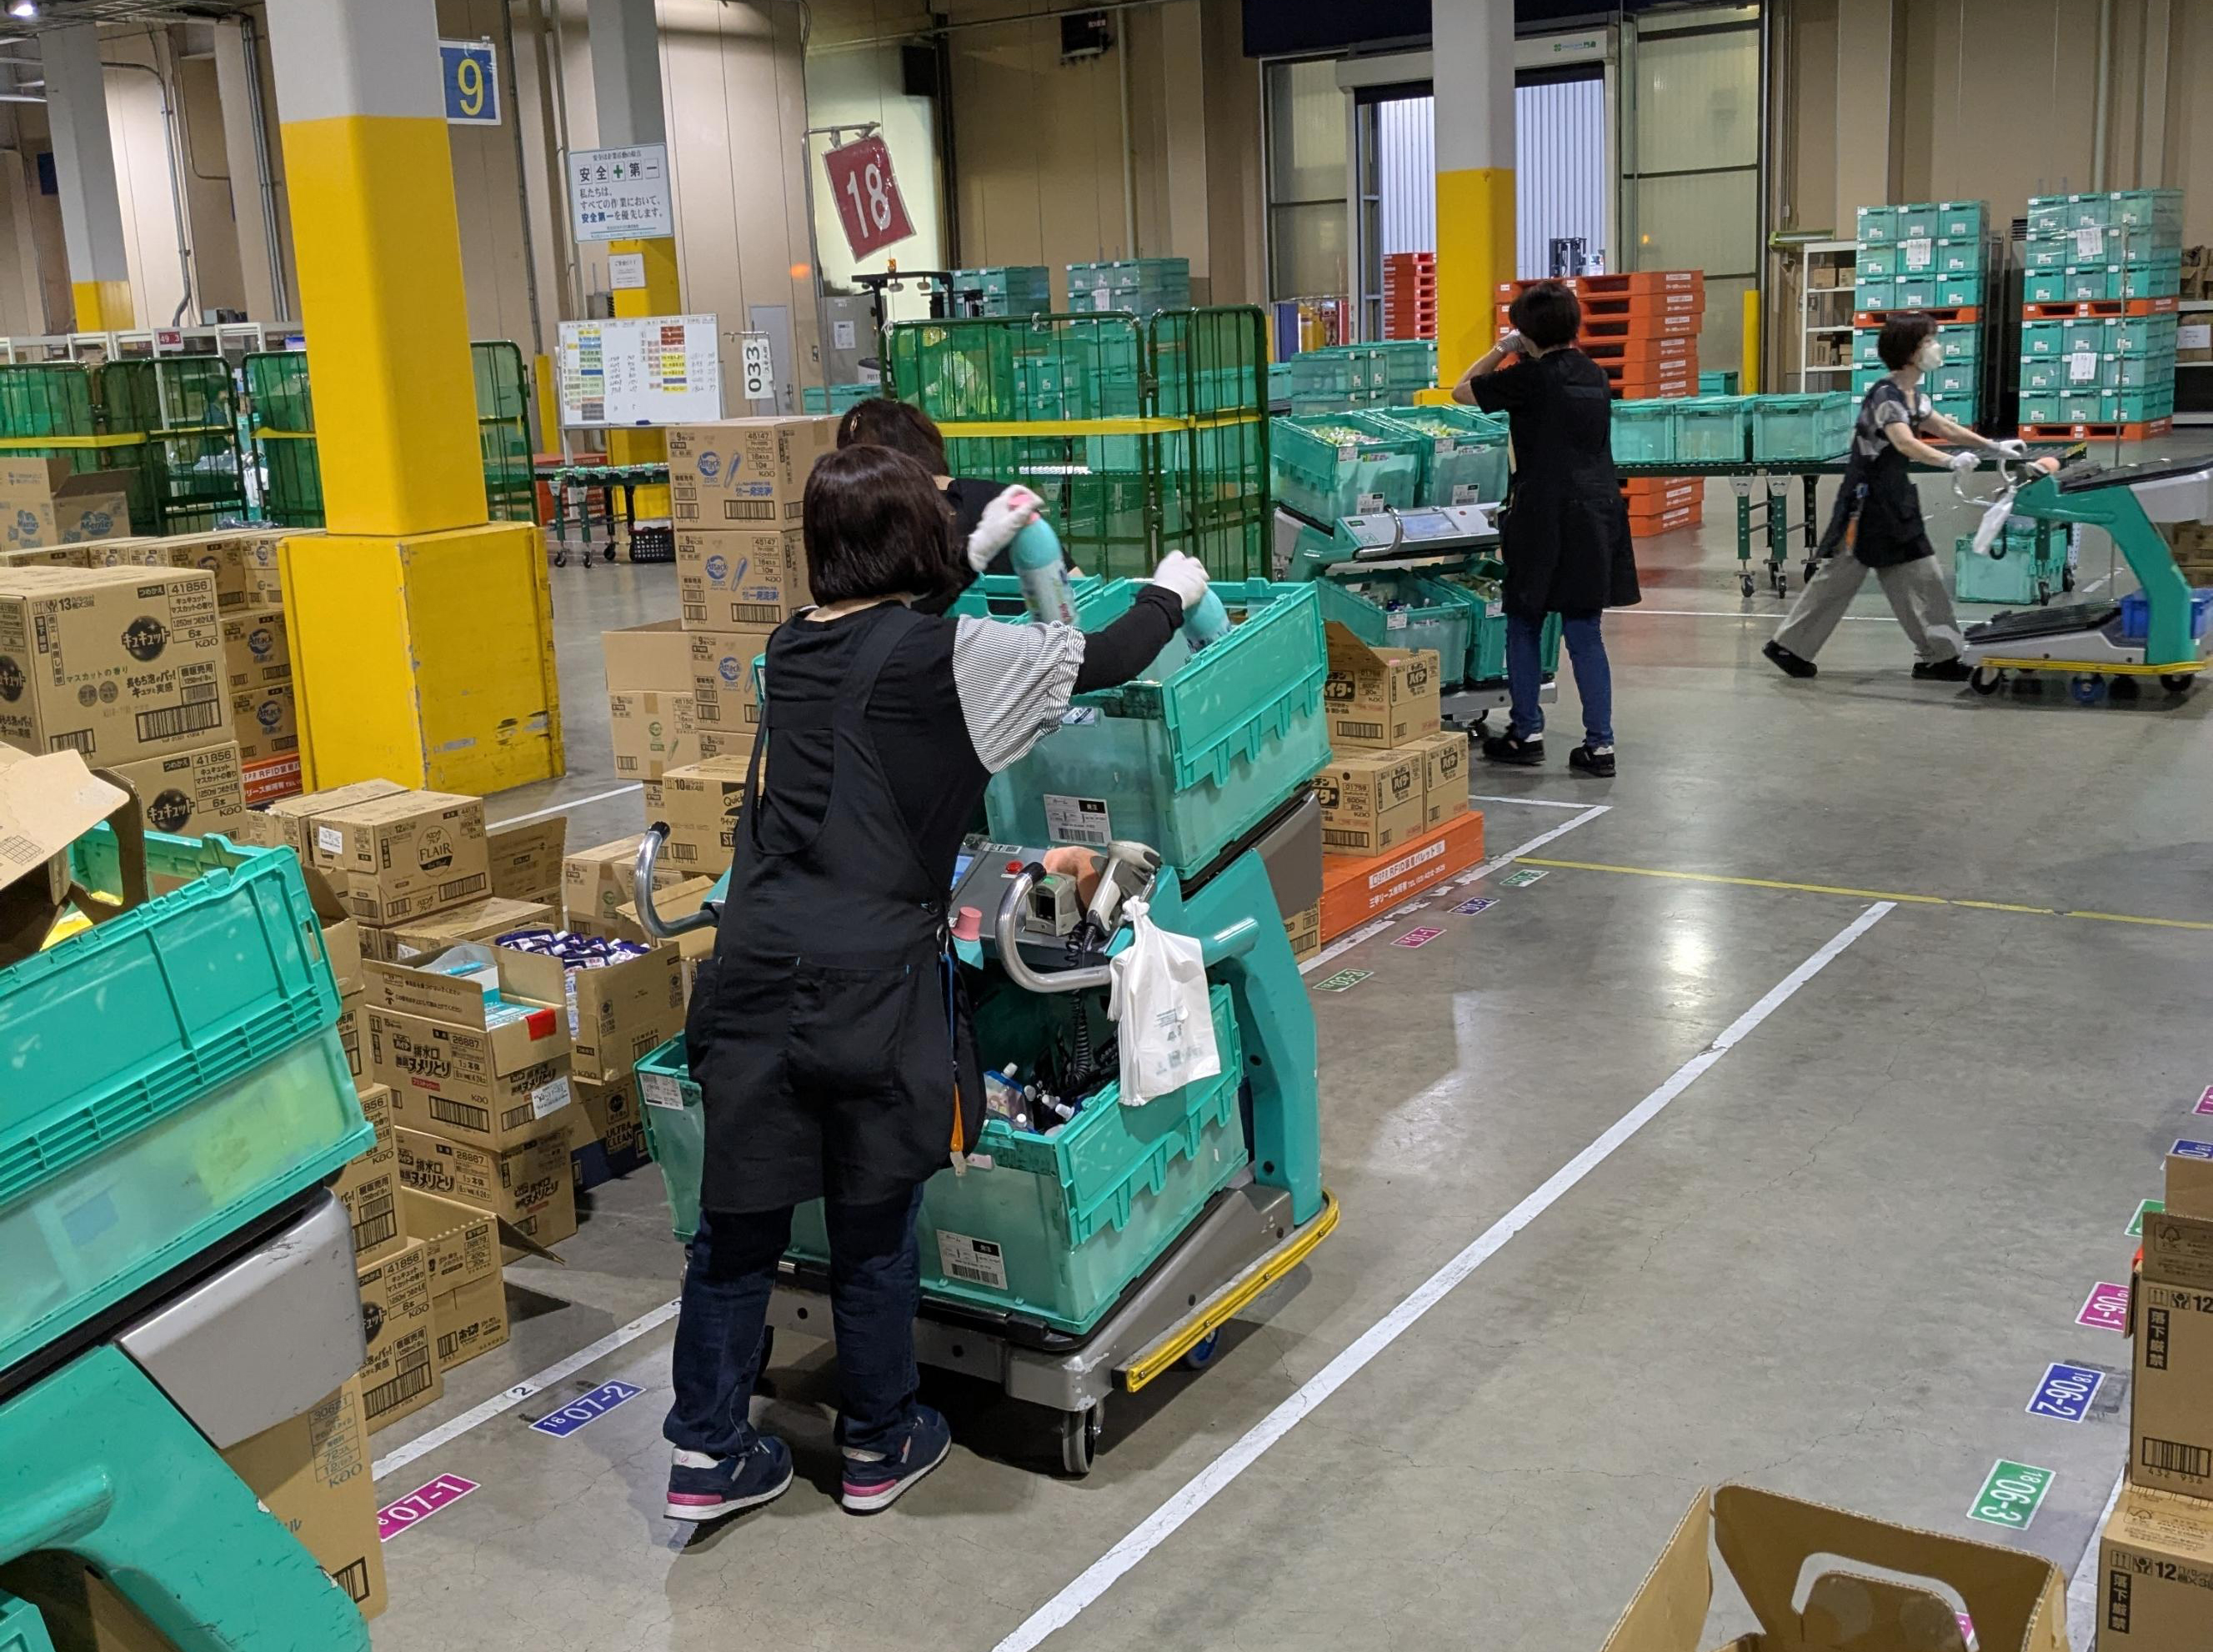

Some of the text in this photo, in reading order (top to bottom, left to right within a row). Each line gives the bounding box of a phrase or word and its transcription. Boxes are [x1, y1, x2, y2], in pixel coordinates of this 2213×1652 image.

[458, 58, 483, 116] 9
[847, 163, 892, 238] 18
[746, 346, 762, 393] 033
[172, 581, 208, 593] 41856
[123, 627, 171, 648] キュキュット
[196, 751, 232, 765] 41856
[148, 798, 195, 822] キュキュット
[419, 843, 453, 861] FLAIR
[606, 1122, 633, 1139] ULTRA
[607, 1131, 633, 1148] CLEAN
[387, 1253, 420, 1273] 41856
[2150, 1311, 2165, 1368] 落下厳禁
[543, 1384, 634, 1429] 18 07-2
[2035, 1372, 2094, 1416] 18 06-2
[329, 1463, 363, 1489] Kao
[388, 1481, 464, 1521] 07-1
[1980, 1470, 2044, 1523] 18 06-3
[2154, 1561, 2176, 1581] 12
